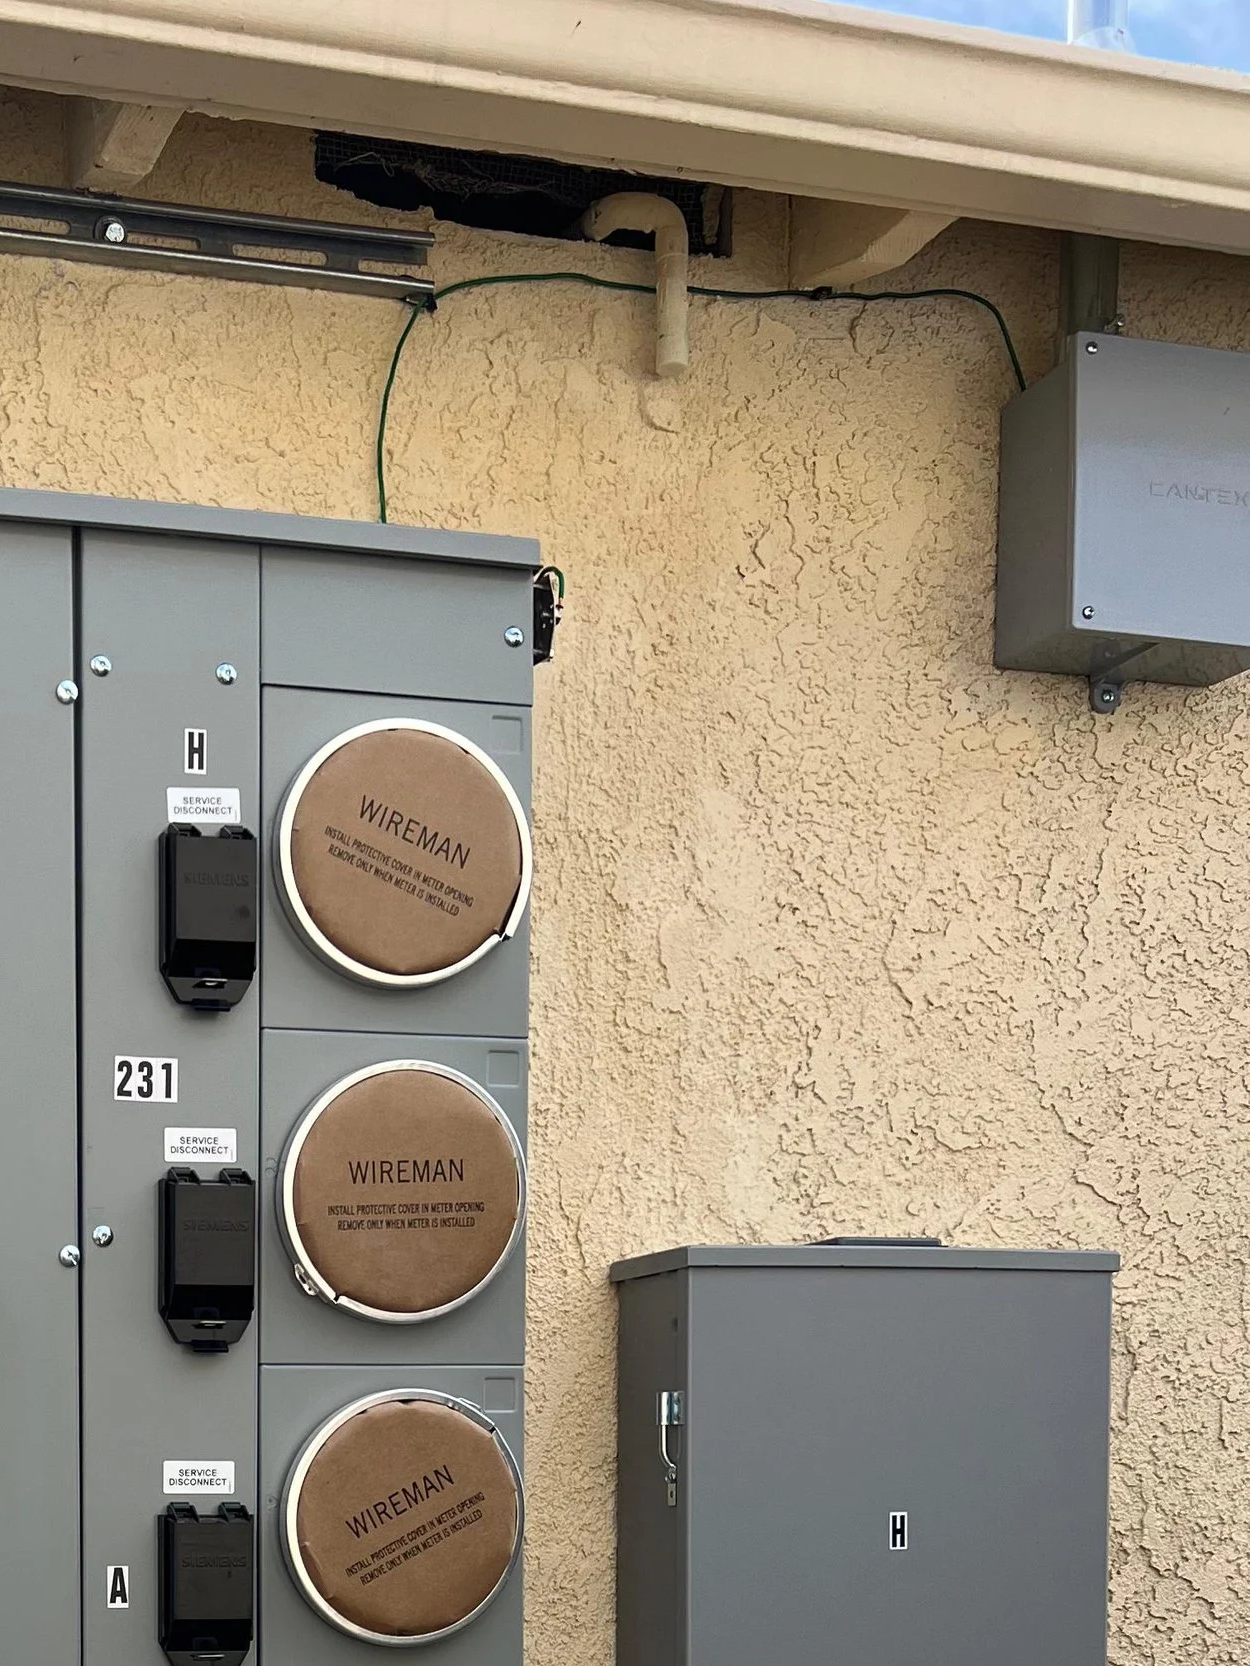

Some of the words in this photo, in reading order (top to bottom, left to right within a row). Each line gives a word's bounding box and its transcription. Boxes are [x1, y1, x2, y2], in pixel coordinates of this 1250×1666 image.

[188, 731, 204, 770] H
[173, 806, 233, 815] DISCONNECT
[183, 796, 222, 805] SERVICE
[360, 794, 470, 870] WIREMAN
[325, 826, 350, 847] INSTALL
[352, 839, 391, 866] PROTECTIVE
[392, 859, 411, 875] COVER
[413, 871, 421, 880] IN
[422, 876, 444, 892] METER
[445, 886, 474, 907] OPENING
[329, 844, 354, 866] REMOVE
[356, 858, 373, 874] ONLY
[374, 866, 393, 883] WHEN
[394, 876, 416, 896] METER
[416, 889, 423, 899] IS
[425, 892, 459, 917] INSTALLED
[117, 1060, 172, 1098] 231
[170, 1146, 228, 1154] DISCONNECT
[179, 1136, 218, 1145] SERVICE
[349, 1159, 463, 1184] WIREMAN
[328, 1205, 354, 1216] INSTALL
[357, 1204, 396, 1215] PROTECTIVE
[398, 1204, 419, 1214] COVER
[421, 1203, 429, 1213] IN
[431, 1203, 453, 1213] METER
[454, 1202, 484, 1213] OPENING
[338, 1220, 365, 1230] REMOVE
[367, 1219, 384, 1230] ONLY
[385, 1219, 405, 1229] WHEN
[407, 1218, 430, 1229] METER
[431, 1218, 438, 1228] IS
[440, 1217, 475, 1227] INSTALLED
[169, 1478, 227, 1486] DISCONNECT
[345, 1464, 454, 1539] WIREMAN
[345, 1558, 371, 1577] INSTALL
[371, 1536, 409, 1562] PROTECTIVE
[407, 1524, 428, 1542] COVER
[428, 1520, 436, 1532] IN
[436, 1508, 457, 1525] METER
[457, 1492, 485, 1514] OPENING
[360, 1565, 386, 1586] REMOVE
[386, 1554, 402, 1571] ONLY
[402, 1544, 422, 1560] WHEN
[422, 1532, 444, 1550] METER
[442, 1528, 450, 1539] IS
[450, 1509, 483, 1534] INSTALLED
[892, 1515, 905, 1547] H
[109, 1567, 128, 1604] A
